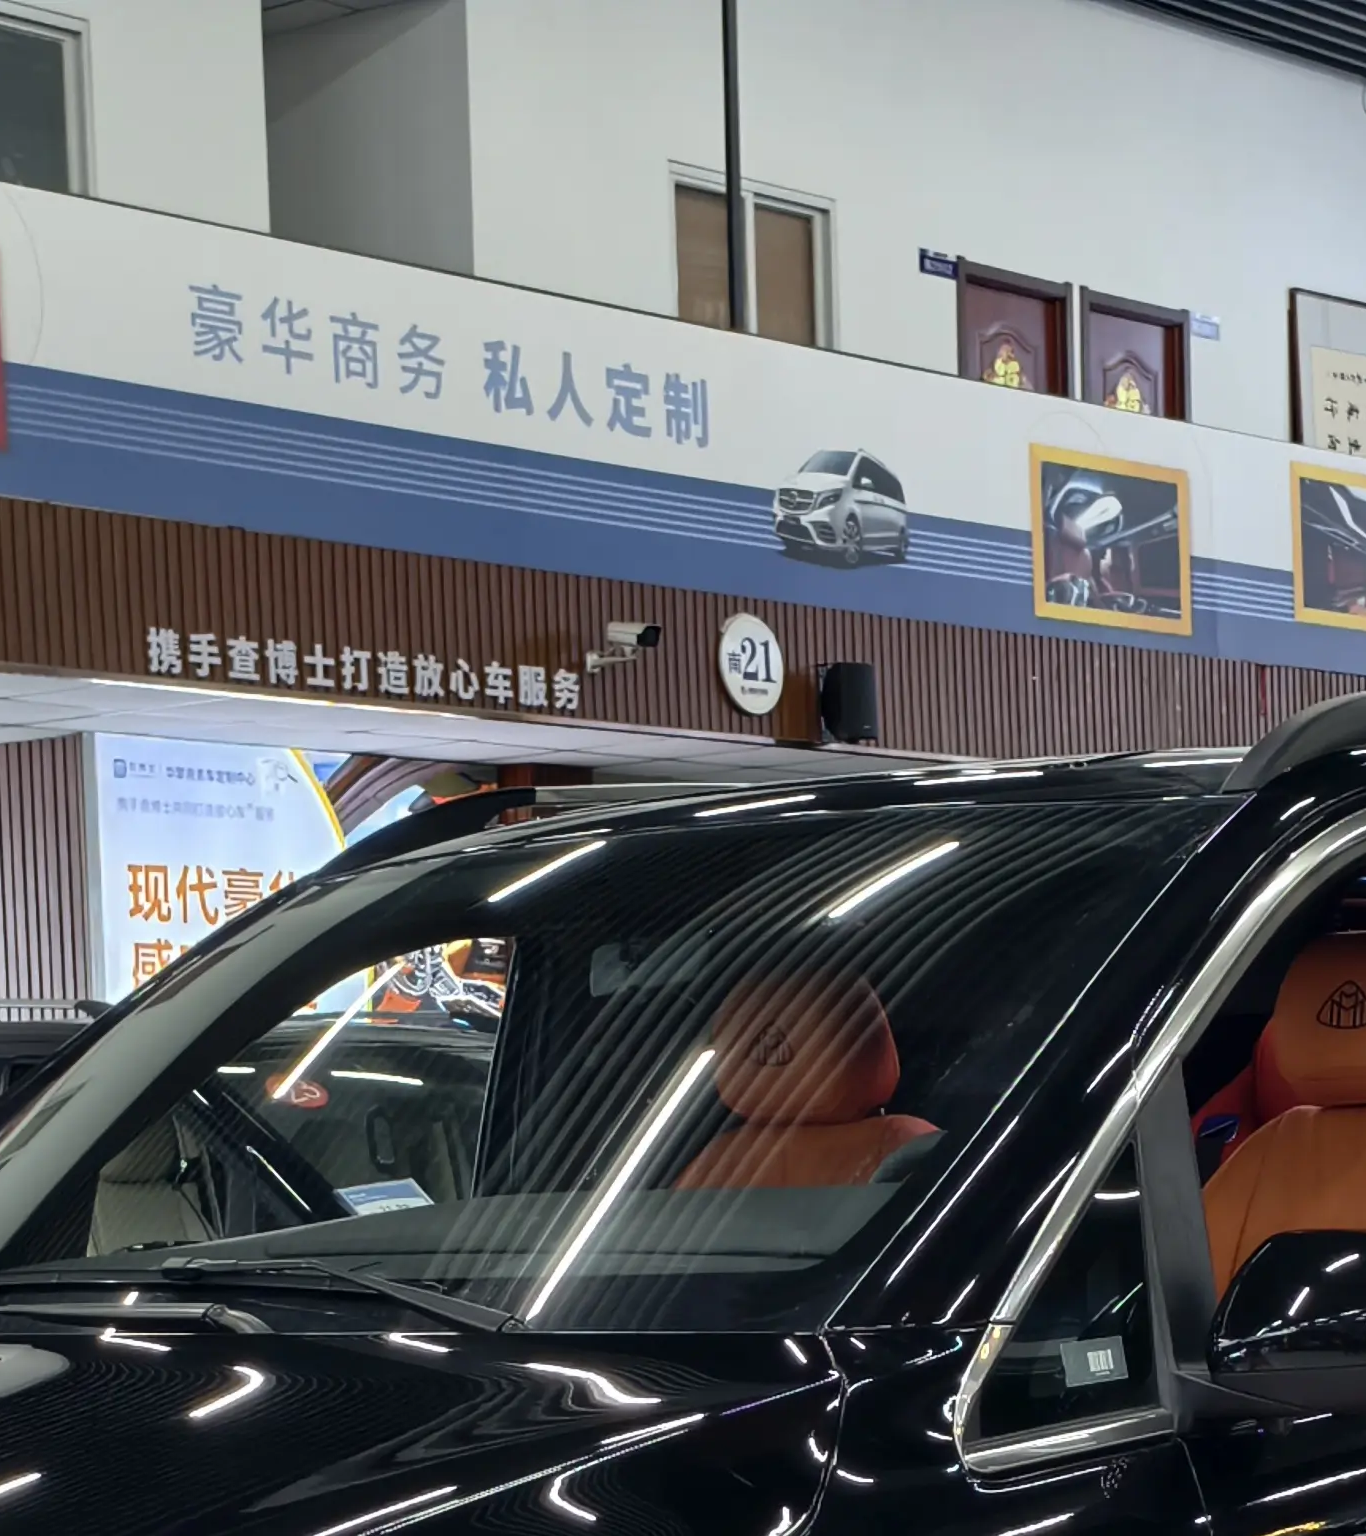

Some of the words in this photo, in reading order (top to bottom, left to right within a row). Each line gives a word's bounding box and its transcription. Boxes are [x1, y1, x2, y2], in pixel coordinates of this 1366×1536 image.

[188, 283, 447, 401] 豪华商务
[482, 339, 710, 449] 私人定制
[146, 625, 582, 712] 携手查博士打造放心车服务
